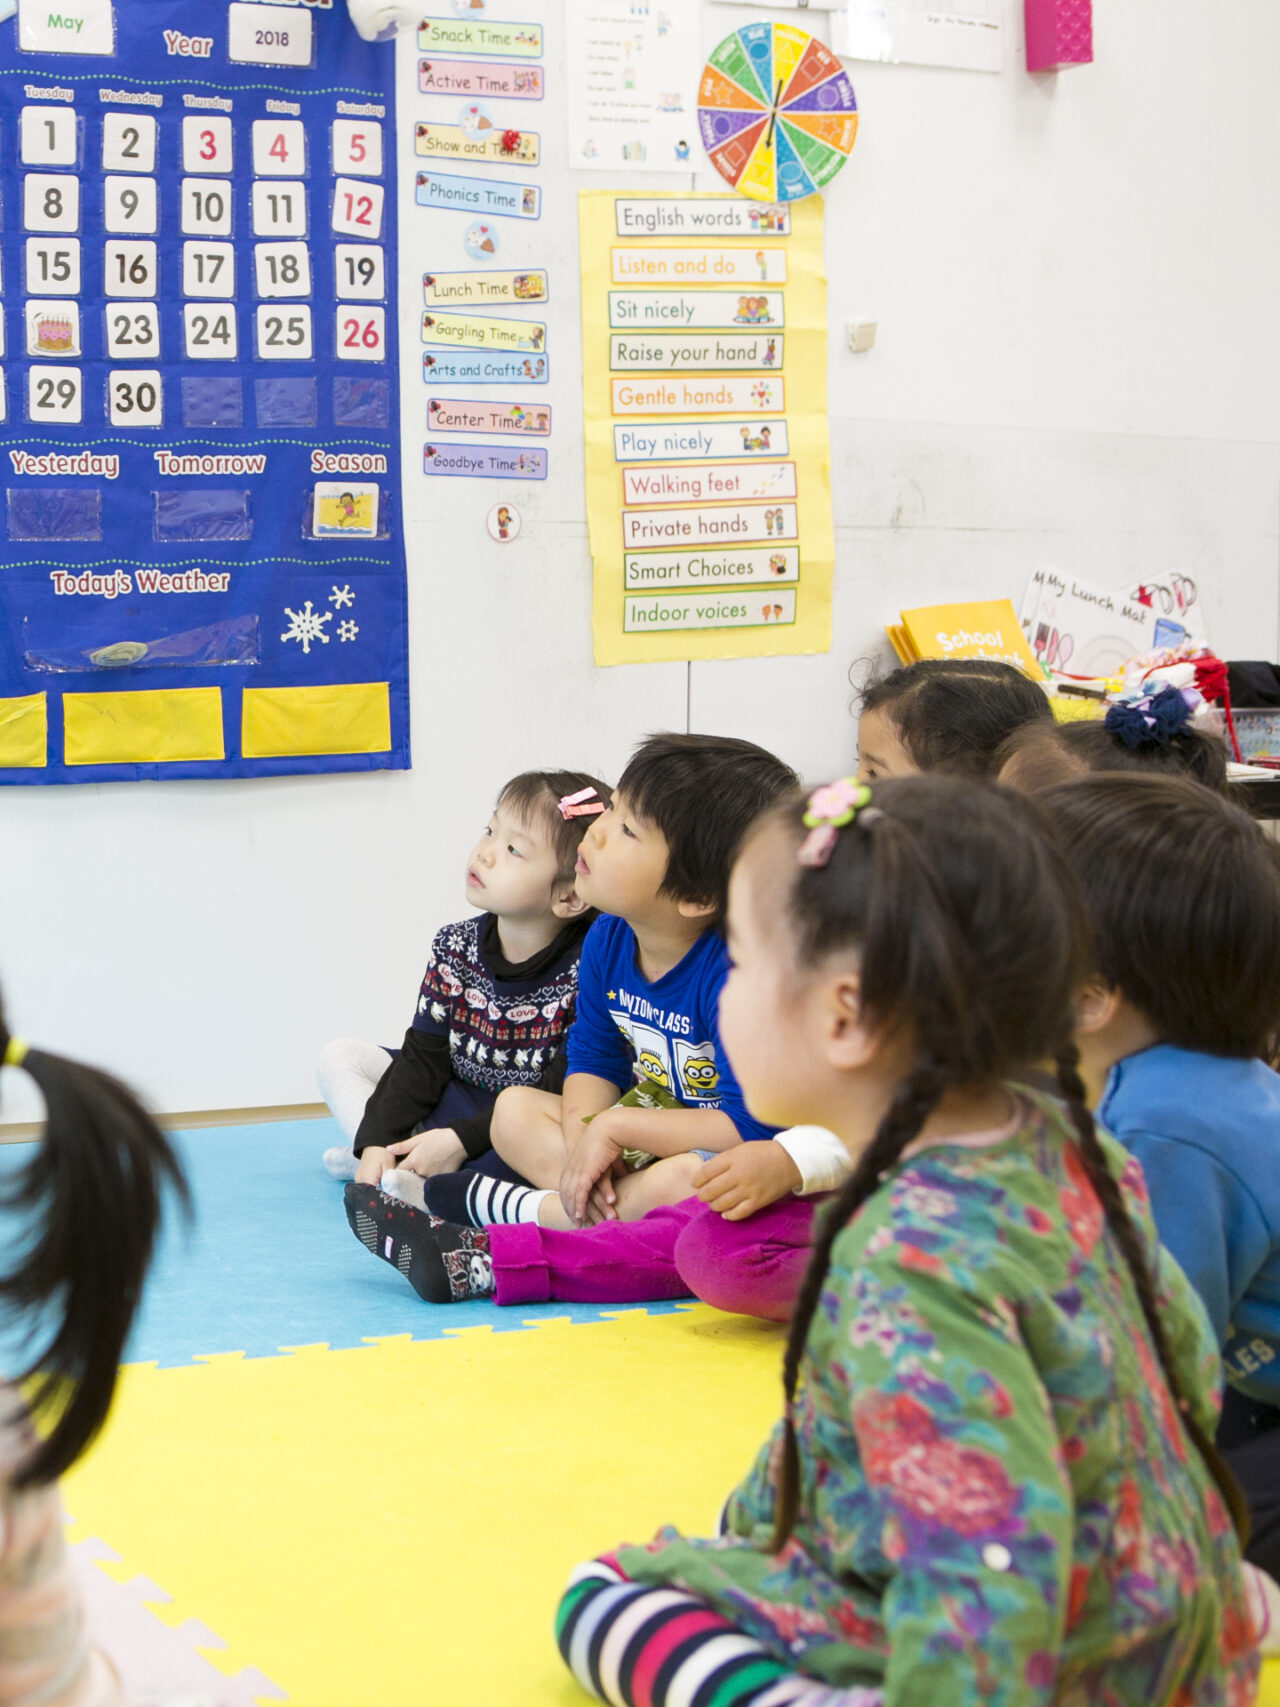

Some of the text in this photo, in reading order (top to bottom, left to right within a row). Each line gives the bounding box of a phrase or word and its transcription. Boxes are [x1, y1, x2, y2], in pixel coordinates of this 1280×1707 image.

[47, 13, 84, 32] May
[166, 30, 289, 57] Year 2018
[431, 27, 511, 45] Snack Time
[425, 73, 509, 92] Active Time
[25, 86, 73, 102] Tuesday
[100, 90, 163, 107] Wednesday
[183, 95, 232, 111] Thursday
[266, 101, 300, 115] Friday
[337, 102, 385, 117] Saturday
[44, 120, 366, 163] 1 2 3 4 5
[426, 137, 459, 152] Show
[464, 141, 486, 154] and
[43, 188, 62, 218] 8
[120, 189, 138, 219] 9
[191, 192, 223, 222] 10
[267, 194, 292, 223] 11
[343, 193, 373, 225] 12
[430, 182, 516, 207] Phonics Time
[624, 206, 742, 231] English words
[37, 251, 70, 281] 15
[115, 254, 148, 284] 16
[193, 254, 225, 283] 17
[265, 254, 300, 284] 18
[345, 257, 375, 286] 19
[620, 254, 735, 274] Listen and do
[433, 281, 509, 298] Lunch Time
[617, 298, 695, 324] Sit nicely
[114, 315, 153, 345] 23
[191, 315, 231, 345] 24
[265, 317, 305, 346] 25
[343, 319, 379, 349] 26
[436, 321, 517, 342] Gargling Time
[617, 340, 757, 367] Raise your hand
[429, 363, 523, 376] Arts and Crafts
[36, 378, 75, 409] 29
[115, 382, 156, 413] 30
[618, 384, 734, 406] Gentle hands
[437, 411, 522, 429] Center Time
[621, 430, 713, 456] Play nicely
[11, 451, 386, 478] Yesterday Tomorrow Season
[433, 454, 517, 472] Goodbye Time
[631, 472, 740, 498] Walking feet
[631, 513, 749, 538] Private hands
[629, 557, 754, 580] Smart Choices
[51, 570, 229, 598] Today's Weather
[1046, 573, 1066, 598] My
[1071, 581, 1114, 612] Lunch
[1120, 606, 1147, 625] Mat
[632, 601, 747, 623] Indoor voices
[936, 629, 1003, 652] School
[466, 990, 487, 1007] LOVE
[510, 1008, 536, 1018] LOVE
